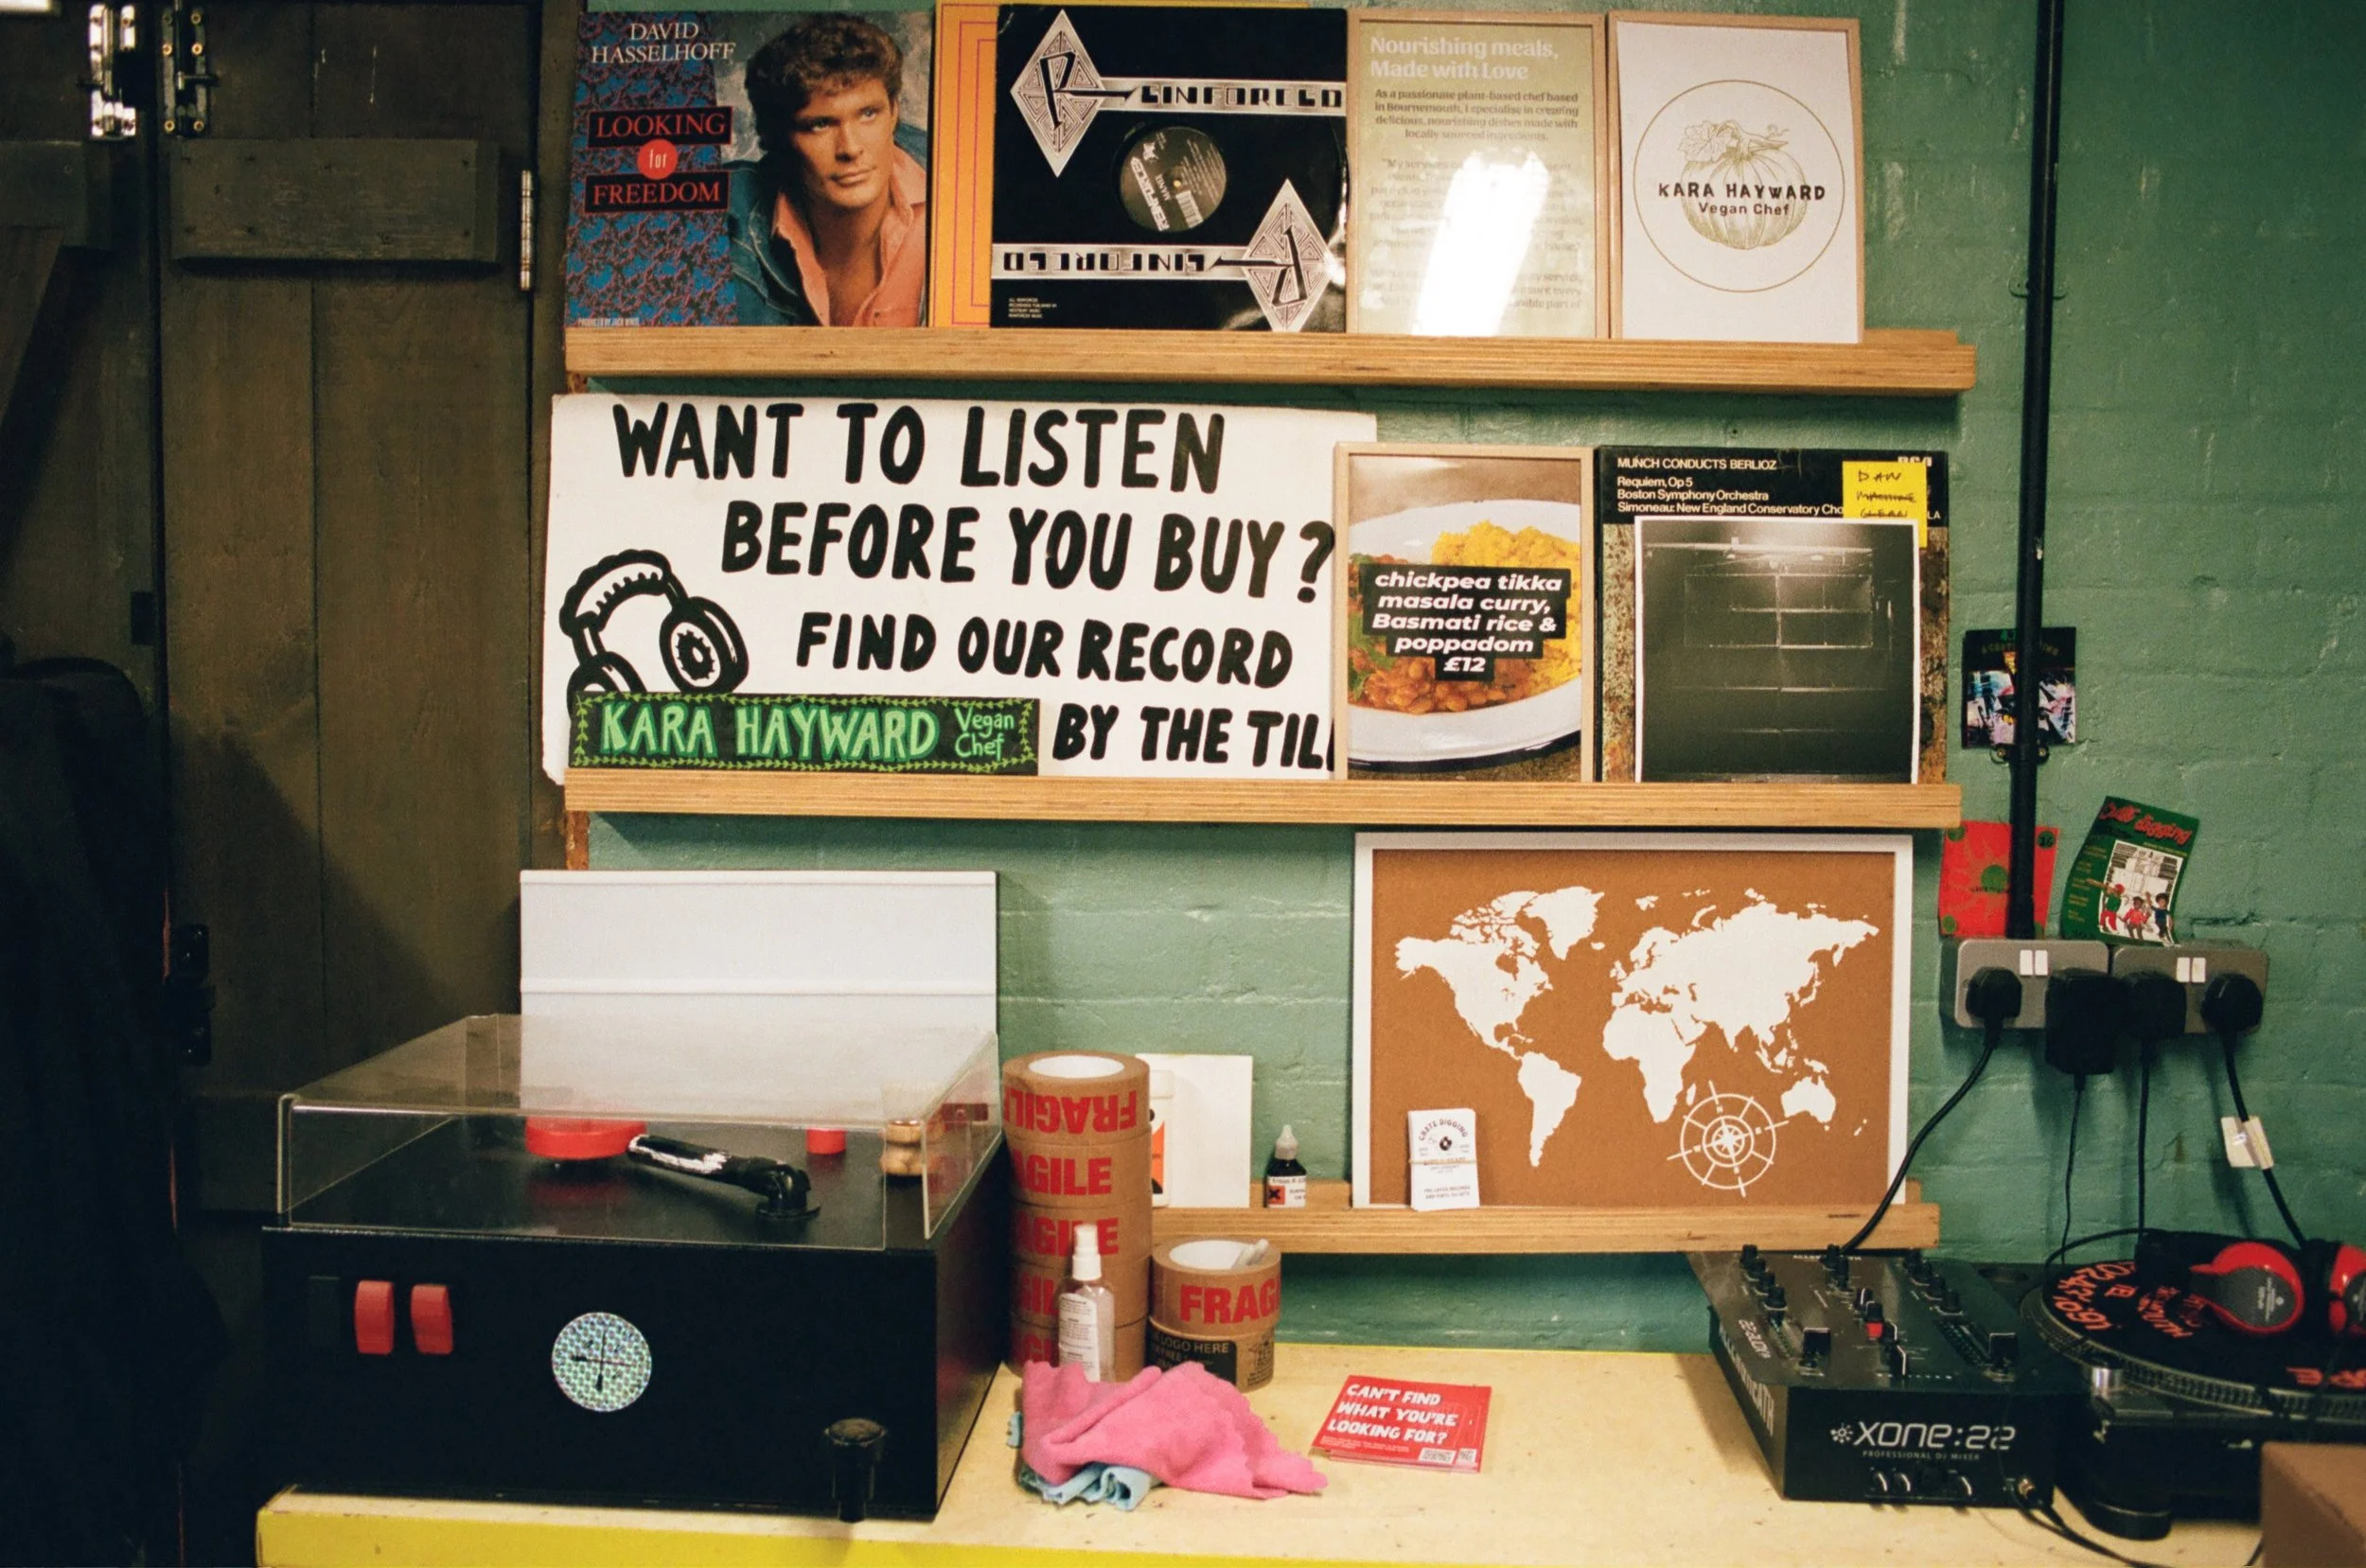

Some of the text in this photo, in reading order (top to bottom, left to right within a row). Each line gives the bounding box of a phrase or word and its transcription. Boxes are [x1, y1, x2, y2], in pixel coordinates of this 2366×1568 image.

[630, 22, 699, 41] DAVID
[592, 43, 735, 63] HASSELHOFF
[1371, 37, 1559, 61] Nourishing meals,
[1371, 61, 1528, 79] Made with Love
[1376, 89, 1387, 98] As
[1398, 90, 1456, 101] passionate
[1457, 90, 1520, 102] plant-based
[1522, 91, 1545, 102] chef
[1545, 92, 1579, 103] based
[1374, 103, 1385, 112] in
[1524, 105, 1533, 114] in
[596, 113, 727, 138] LOOKING
[1554, 118, 1578, 129] with
[648, 150, 668, 169] for
[593, 182, 720, 205] FREEDOM
[1659, 182, 1826, 201] KARA HAYWARD
[1699, 203, 1790, 216] Vegan Chef
[612, 401, 1225, 494] WANT TO LISTEN
[1617, 458, 1777, 470] MUNCH CONDUCTS BERLIOZ
[1617, 477, 1693, 489] Requiem, Op 5
[1617, 490, 1769, 502] Boston Symphony Orchestra
[1676, 503, 1702, 514] New
[1703, 504, 1747, 515] England
[1748, 504, 1819, 516] Conservatory
[721, 500, 1335, 604] BEFORE YOU BUY?
[1375, 572, 1563, 591] chickpea tikka
[1378, 594, 1551, 615] masala curry,
[1372, 614, 1557, 633] Basmati rice &
[796, 611, 1293, 689] FIND OUR RECORD
[1394, 637, 1534, 654] poppadom
[1442, 657, 1487, 673] £12
[599, 701, 940, 762] KARA HAYWARD
[953, 707, 1015, 738] Vegan
[1051, 702, 1120, 761] BY
[1139, 706, 1234, 764] THE
[955, 732, 1005, 758] Chef
[1439, 1119, 1468, 1137] DIGGING
[1194, 1342, 1229, 1354] HERE
[1347, 1383, 1441, 1406] CAN'T FIND
[1336, 1401, 1458, 1427] WHAT YOU'RE
[1327, 1418, 1401, 1439] LOOKING
[1404, 1428, 1448, 1445] FOR?
[1863, 1450, 1932, 1460] PROFESSIONAL
[1951, 1453, 1980, 1461] MIXER
